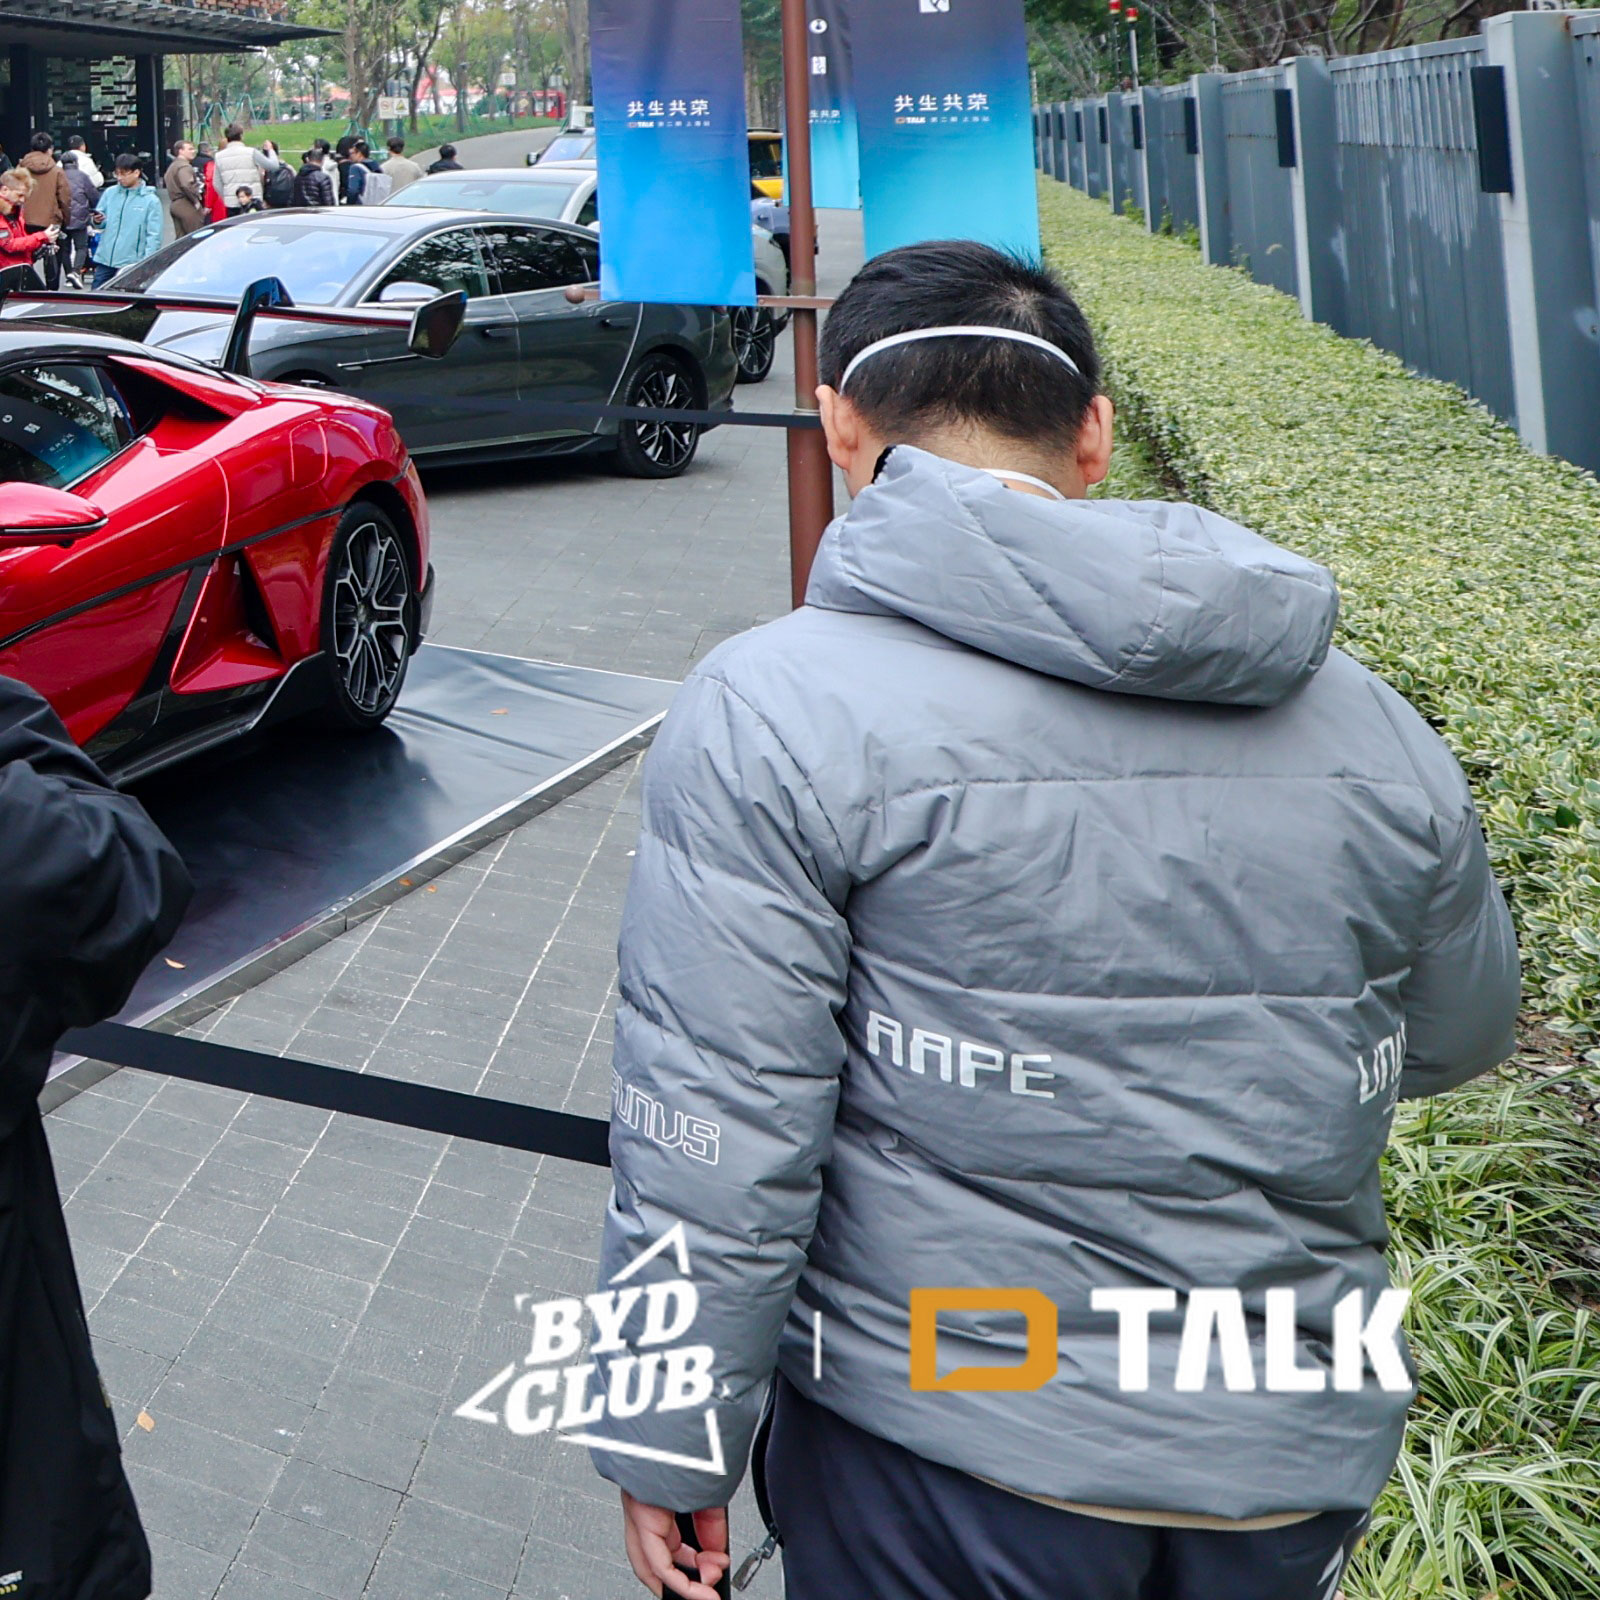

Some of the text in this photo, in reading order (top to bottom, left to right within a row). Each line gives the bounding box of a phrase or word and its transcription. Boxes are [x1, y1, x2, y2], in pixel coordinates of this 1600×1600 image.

[626, 99, 711, 118] 共生共荣
[809, 109, 841, 119] 生共荣
[894, 92, 990, 114] 共生共荣
[866, 1009, 1055, 1099] AAPE
[612, 1067, 721, 1166] UNVS
